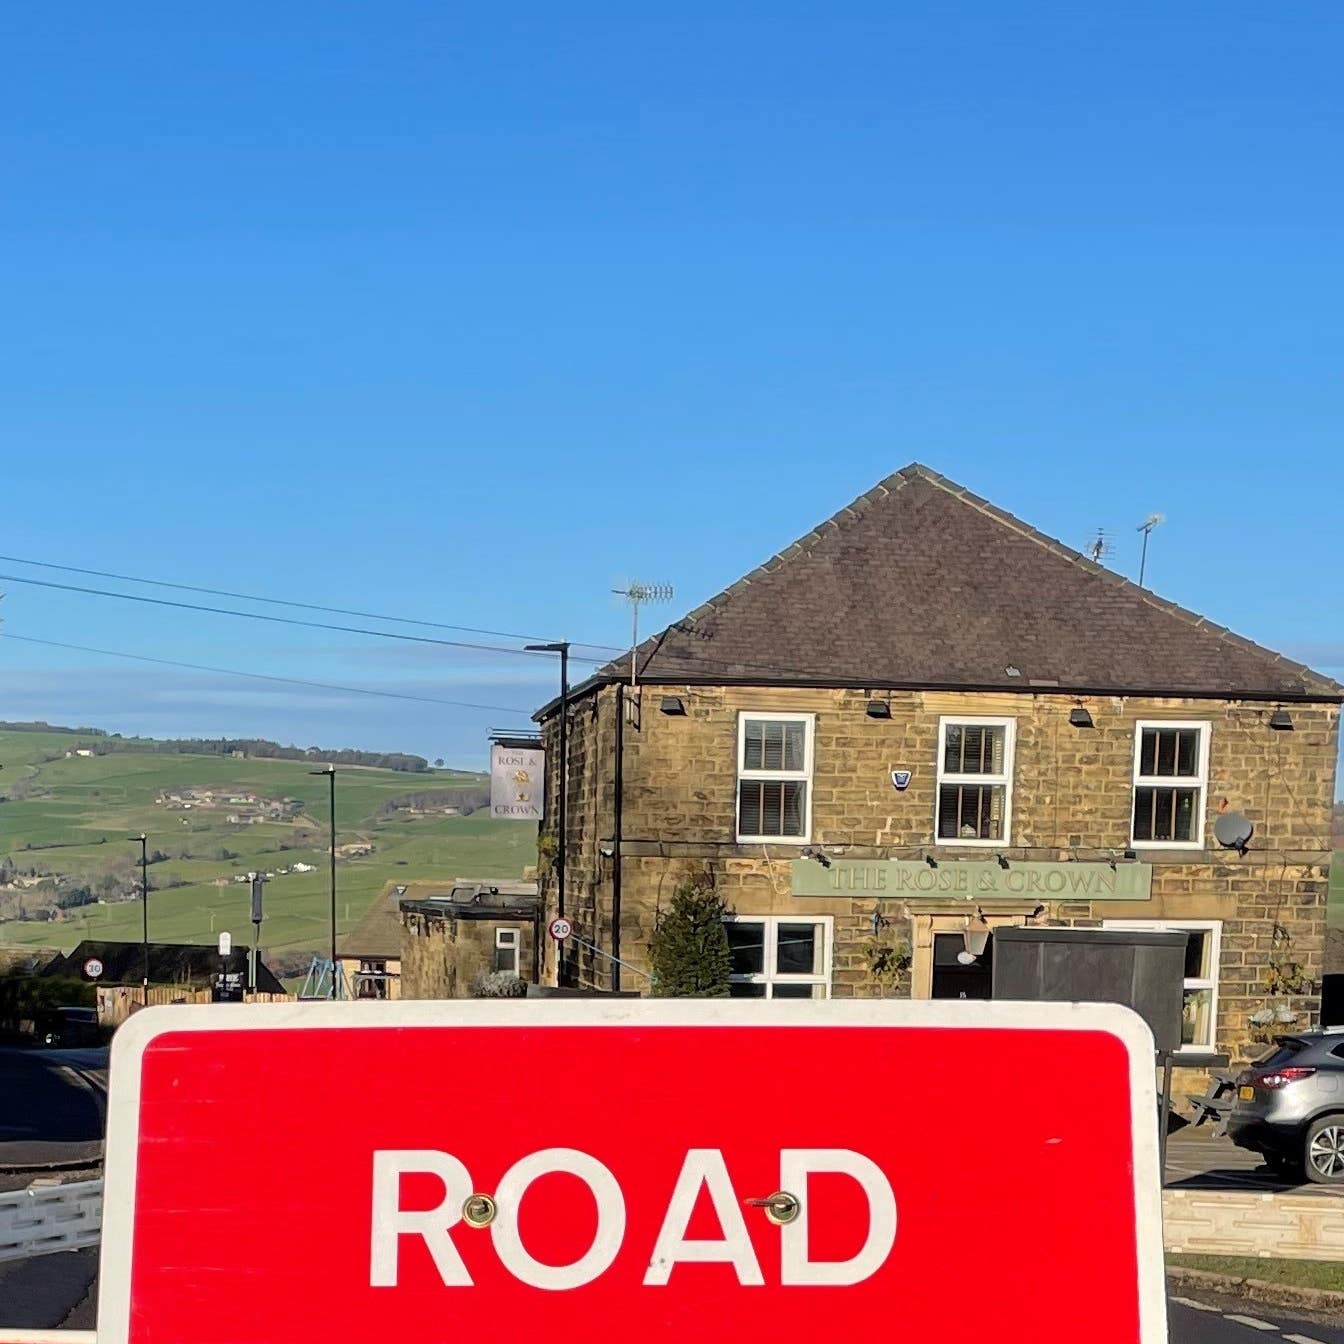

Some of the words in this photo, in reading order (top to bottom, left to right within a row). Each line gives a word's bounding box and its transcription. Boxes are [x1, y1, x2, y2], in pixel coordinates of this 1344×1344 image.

[494, 804, 540, 817] CROWN
[828, 866, 888, 890] THE
[896, 867, 969, 892] ROSE
[976, 869, 1000, 892] &
[1007, 868, 1118, 894] CROWN
[554, 924, 569, 934] 20
[370, 1147, 898, 1291] ROAD
